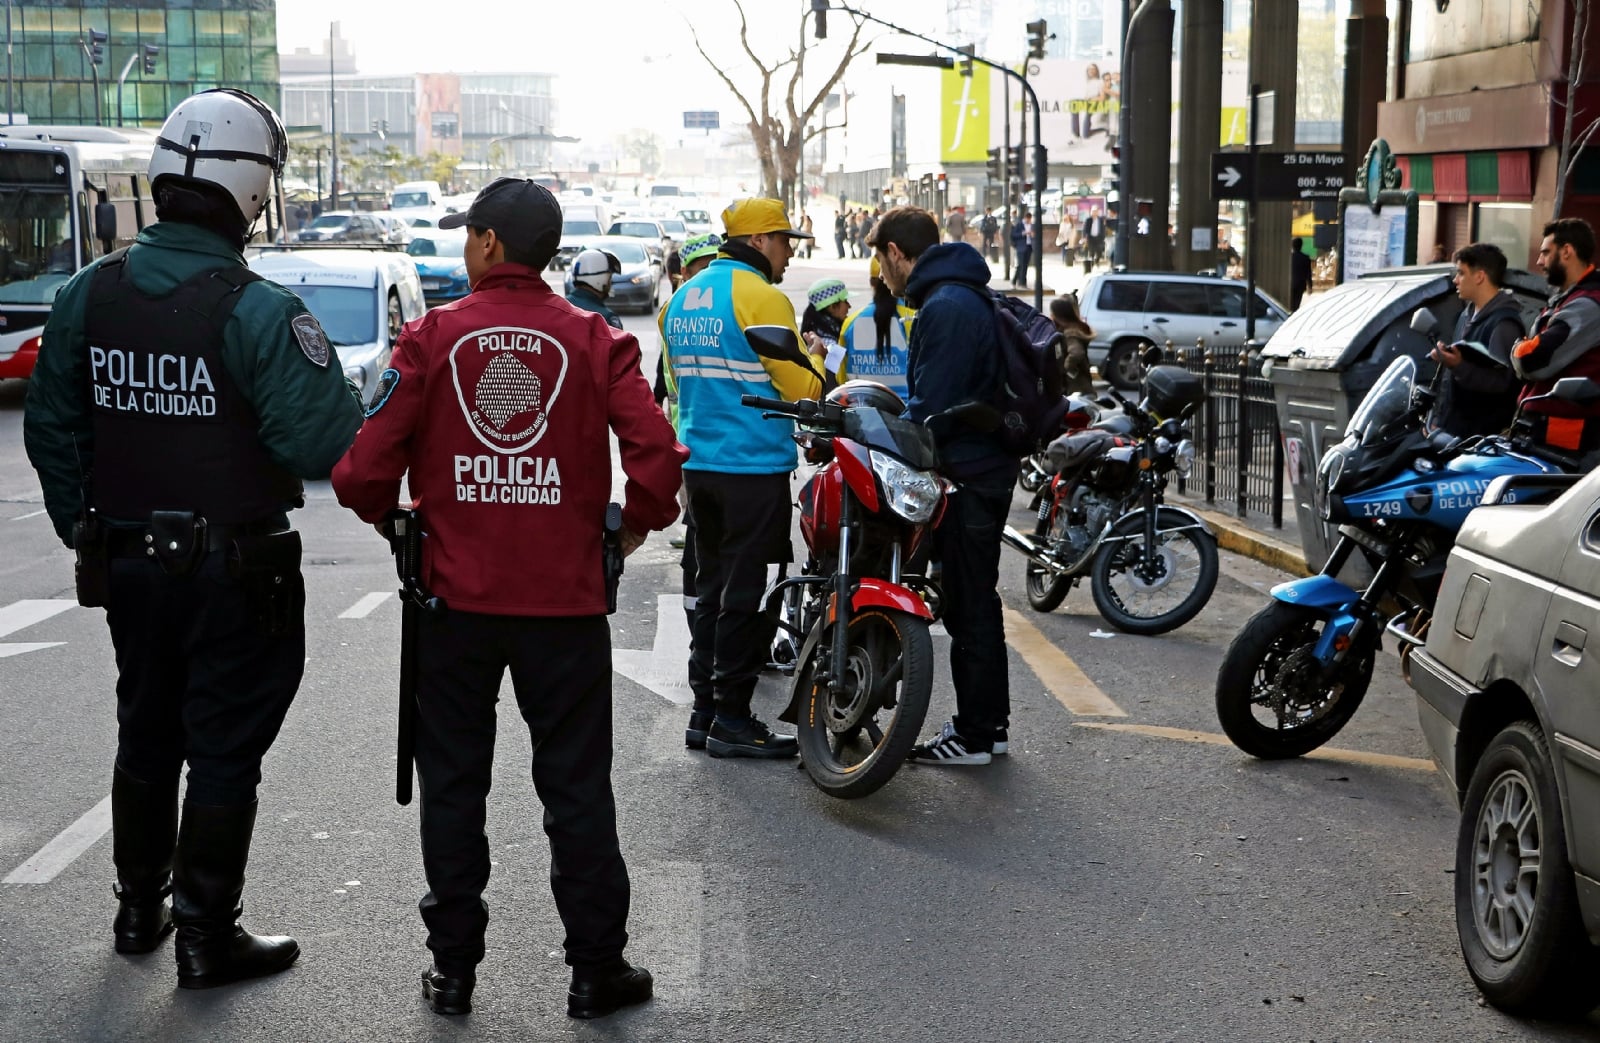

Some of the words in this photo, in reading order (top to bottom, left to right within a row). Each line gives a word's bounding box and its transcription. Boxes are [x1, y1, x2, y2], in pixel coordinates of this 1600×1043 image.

[1283, 154, 1297, 165] 25
[1298, 153, 1313, 165] De
[1315, 153, 1344, 167] Mayo
[1297, 176, 1317, 188] 800
[1324, 176, 1344, 188] 700
[668, 316, 724, 336] TRANSITO
[477, 333, 542, 355] POLICIA
[678, 335, 690, 347] LA
[90, 346, 216, 392] POLICIA
[860, 365, 871, 375] LA
[871, 365, 902, 376] CIUDAD
[94, 383, 113, 409] DE
[116, 388, 139, 412] LA
[143, 391, 217, 417] CIUDAD
[471, 410, 479, 421] DE
[482, 424, 502, 440] CIUDAD
[502, 434, 512, 442] DE
[511, 426, 536, 442] BUENOS
[533, 411, 546, 430] AIRES
[454, 455, 562, 486] POLICIA
[456, 484, 478, 502] DE
[480, 484, 499, 503] LA
[500, 485, 562, 506] CIUDAD
[1439, 497, 1456, 510] DE
[1458, 495, 1474, 509] LA
[1363, 501, 1402, 517] 1749
